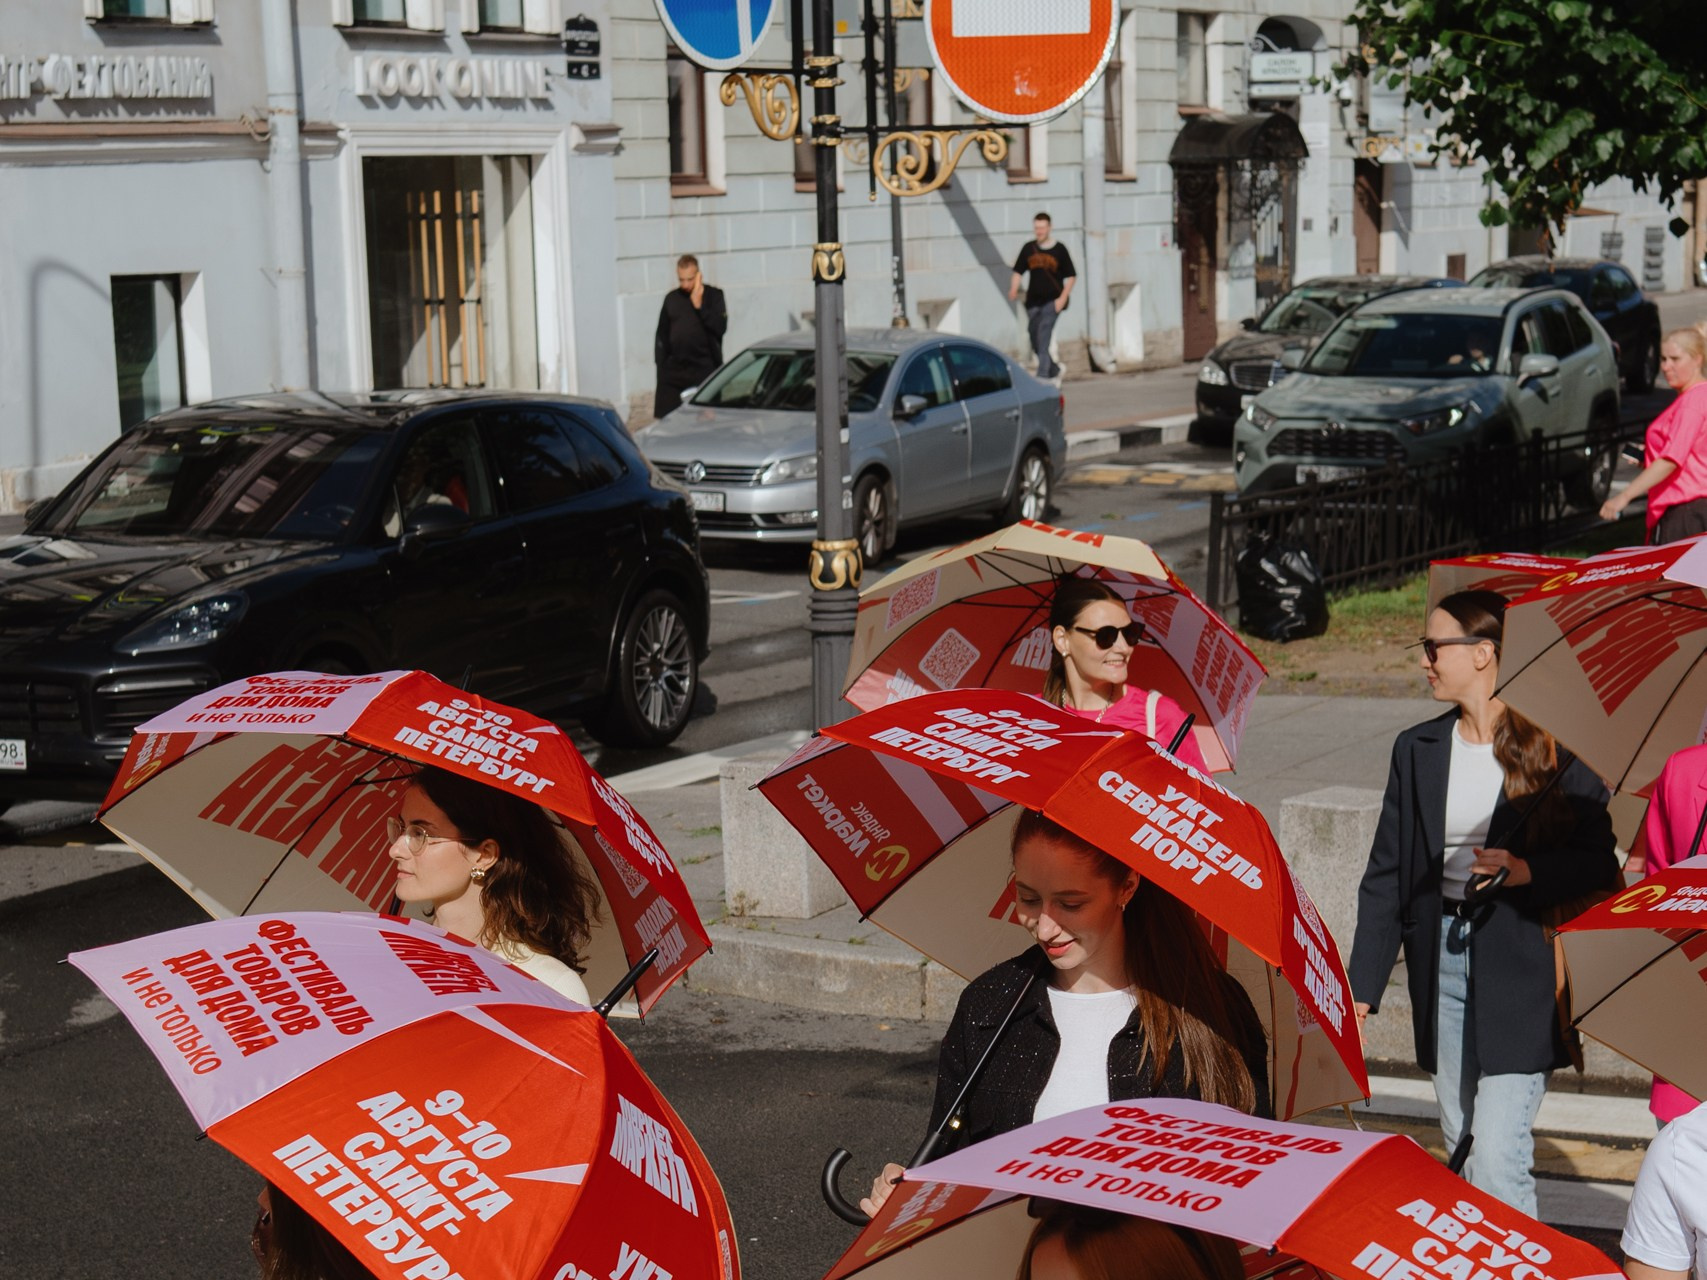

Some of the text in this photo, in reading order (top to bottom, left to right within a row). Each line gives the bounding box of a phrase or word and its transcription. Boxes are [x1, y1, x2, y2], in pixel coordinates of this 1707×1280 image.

[43, 54, 212, 99] ФЕХТОВАНИЯ
[354, 55, 554, 98] LOOK ONLINE
[204, 695, 337, 709] ДЛЯ ДОМА
[241, 686, 352, 695] ТОВАРОВ
[416, 700, 541, 753] АВГУСТА
[428, 720, 526, 762] САНКТ-
[923, 722, 1024, 758] САНКТ-
[934, 707, 1062, 751] АВГУСТА
[394, 727, 555, 794] ПЕТЕРБУРГ
[869, 727, 1031, 784] ПЕТЕРБУРГ
[1098, 770, 1263, 890] СЕВКАБЕЛЬ
[1158, 785, 1224, 829] УКТ
[1130, 824, 1218, 885] ПОРТ
[162, 949, 280, 1058] ДЛЯ ДОМА
[223, 943, 321, 1036] ТОВАРОВ
[257, 919, 375, 1036] ФЕСТИВАЛЬ
[357, 1091, 514, 1223] АВГУСТА
[1095, 1123, 1289, 1167] ТОВАРОВ
[1103, 1105, 1344, 1156] ФЕСТИВАЛЬ
[343, 1132, 466, 1236] САНКТ-
[609, 1112, 699, 1218] МАРКЕТА
[1030, 1136, 1263, 1189] ДЛЯ ДОМА
